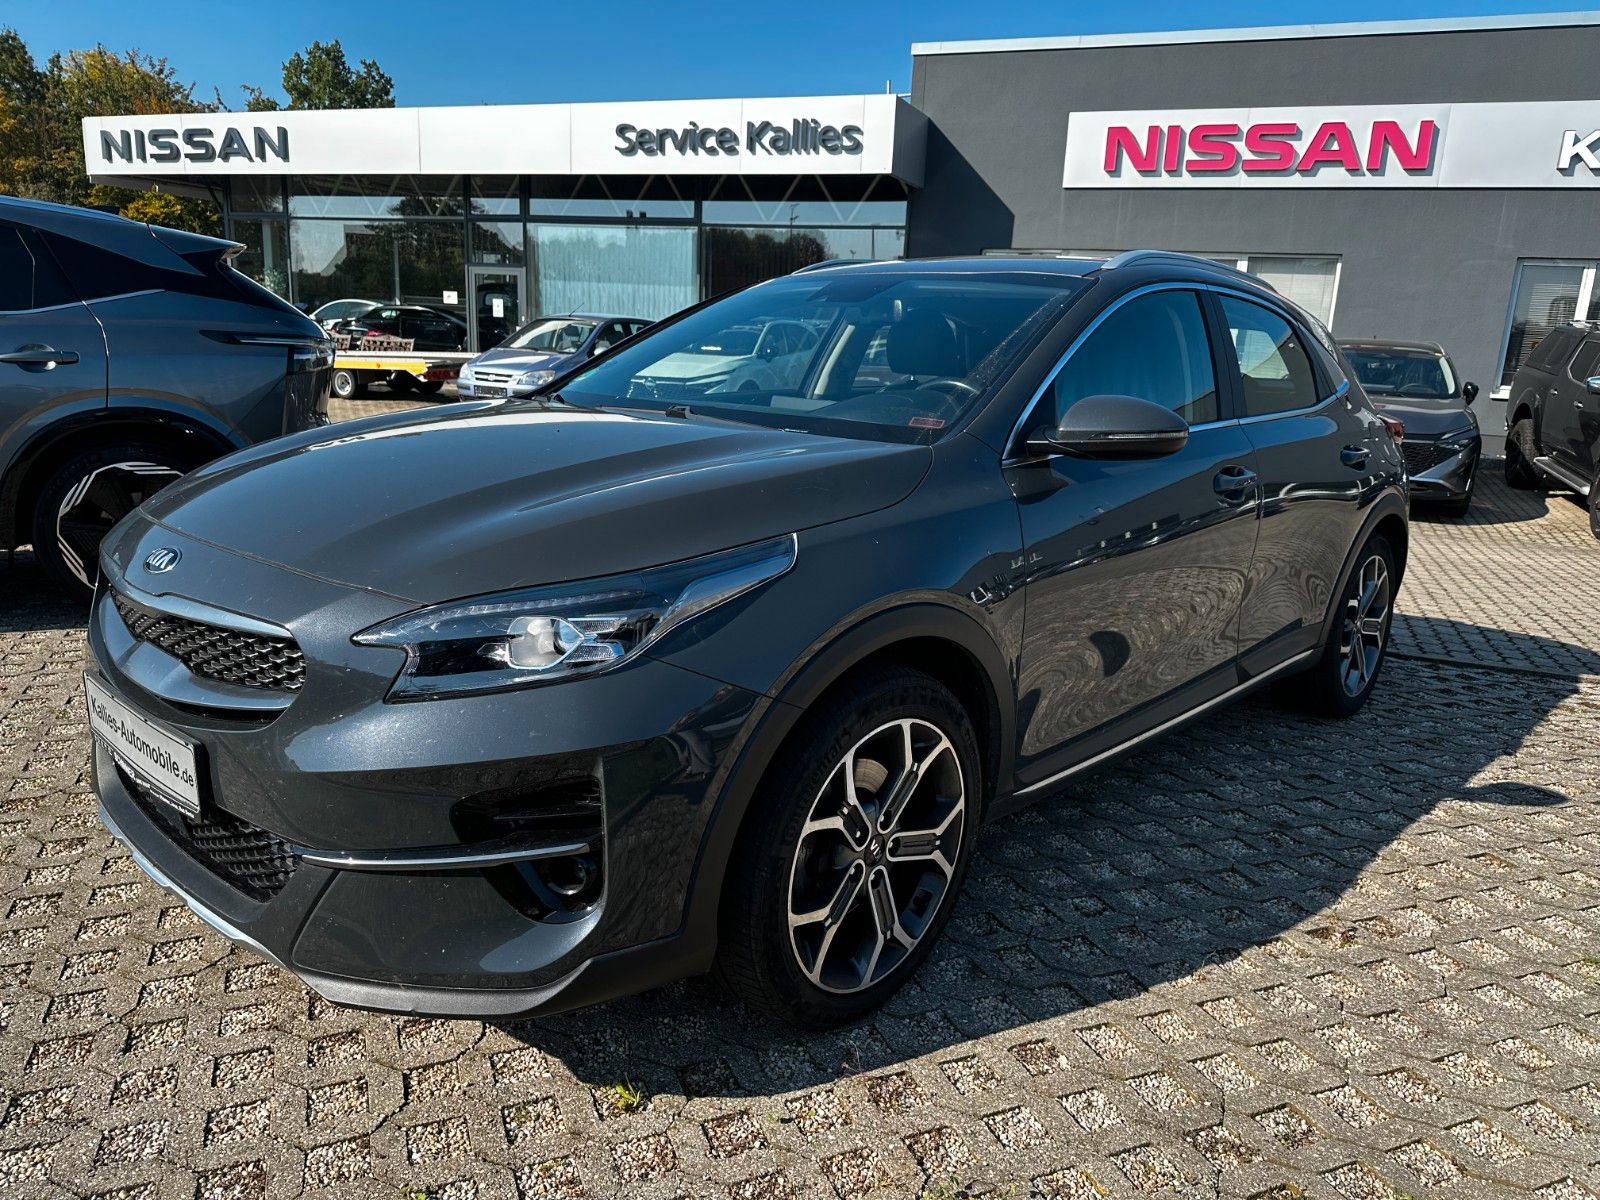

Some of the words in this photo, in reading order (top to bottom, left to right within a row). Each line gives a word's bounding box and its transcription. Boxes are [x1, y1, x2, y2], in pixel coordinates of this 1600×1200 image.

[100, 127, 290, 164] NISSAN
[615, 121, 740, 157] Service
[746, 118, 865, 156] Kallies
[1103, 120, 1440, 177] NISSAN
[146, 548, 176, 570] KIA
[91, 695, 194, 787] Kallies-Automobile.de
